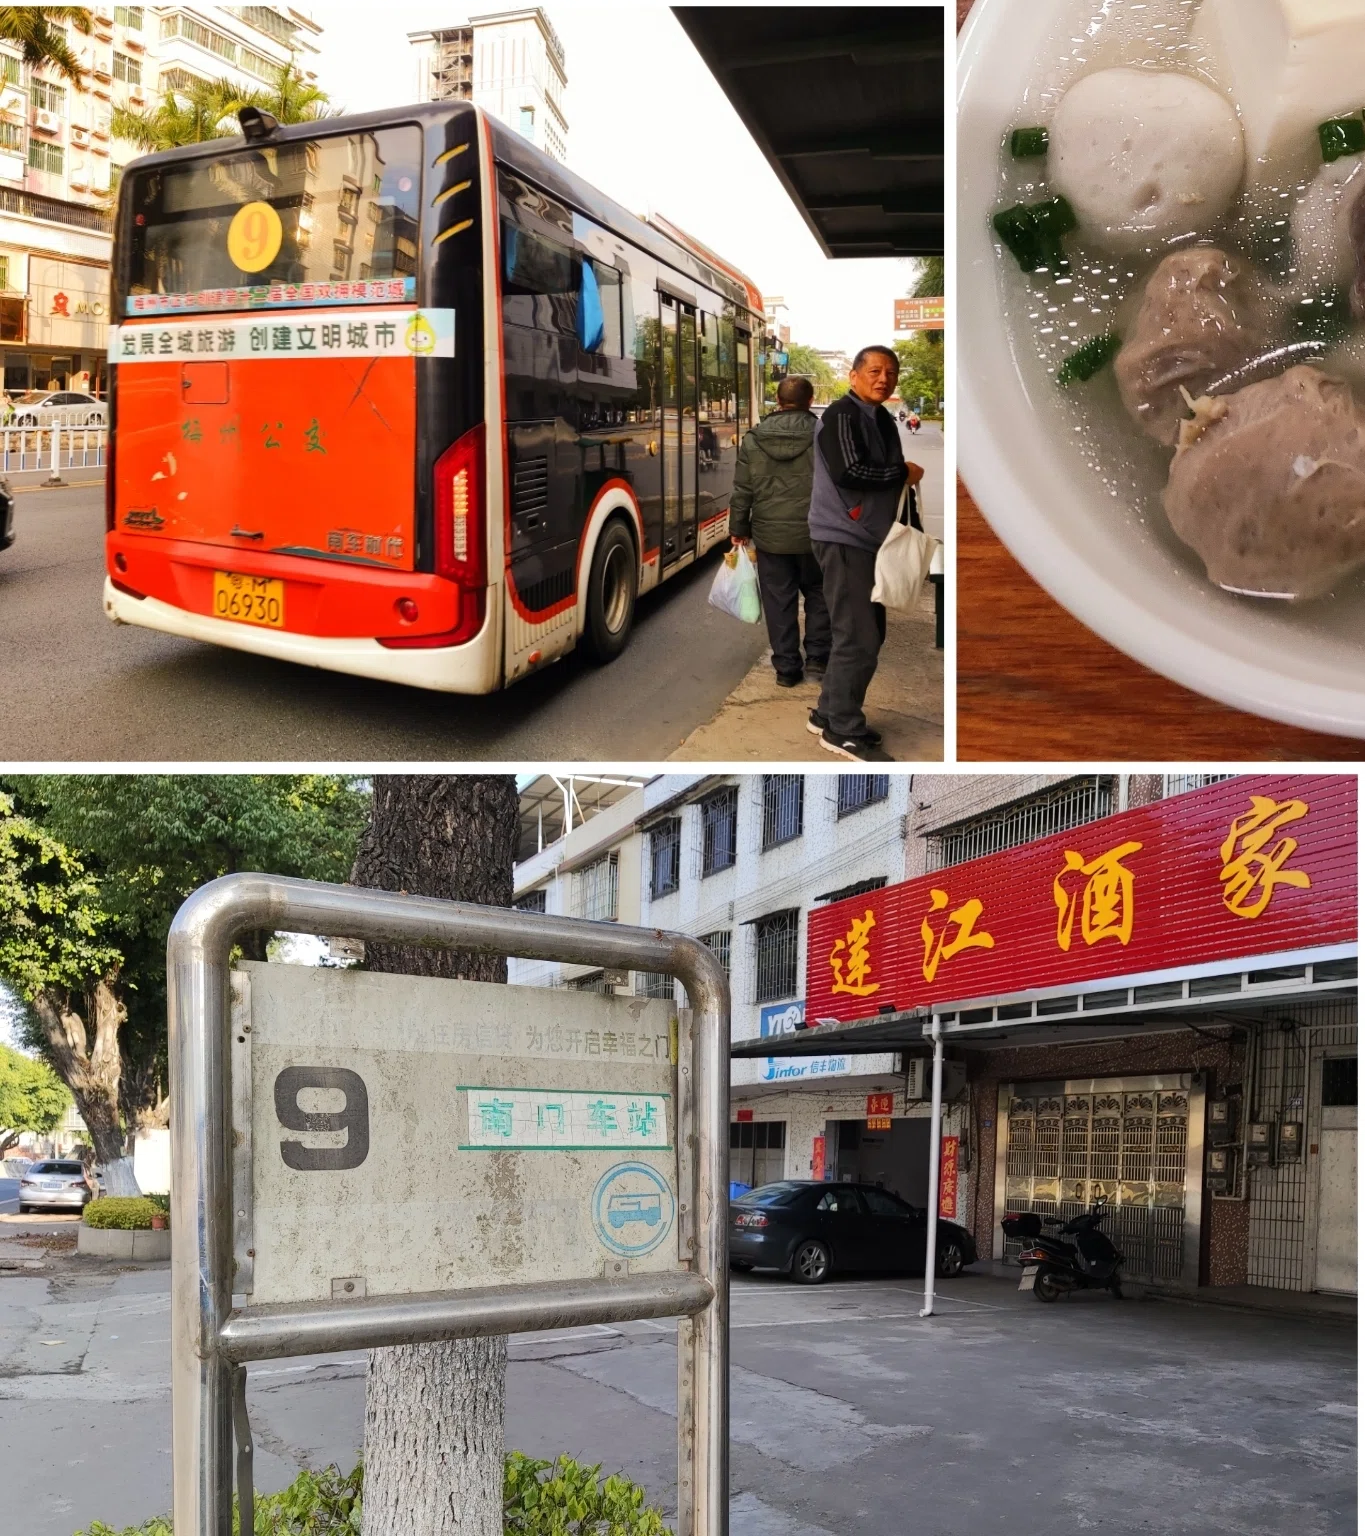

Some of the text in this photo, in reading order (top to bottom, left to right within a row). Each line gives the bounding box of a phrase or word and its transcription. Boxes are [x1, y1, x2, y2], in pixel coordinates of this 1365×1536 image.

[241, 209, 270, 261] 9
[121, 321, 397, 356] 发展全域旅游 创建文明城市
[216, 589, 281, 624] 06930
[526, 1024, 671, 1060] 为您开启幸福之门
[273, 1065, 370, 1172] 9
